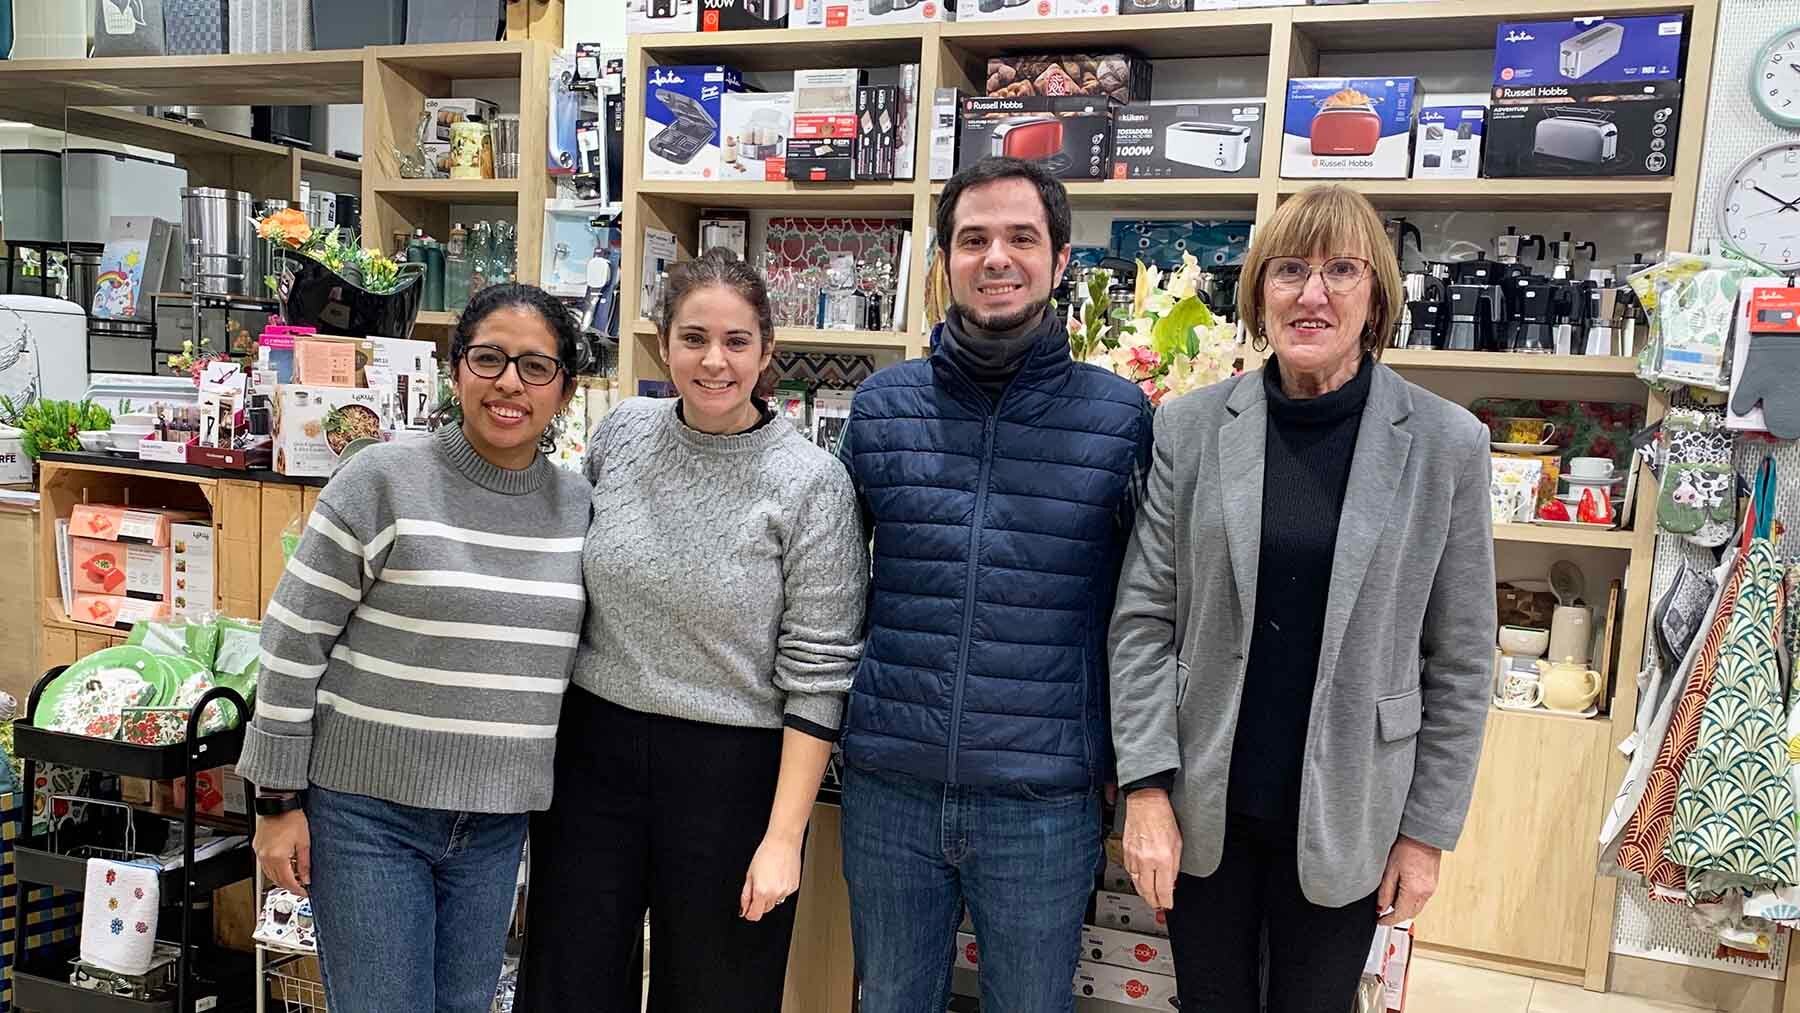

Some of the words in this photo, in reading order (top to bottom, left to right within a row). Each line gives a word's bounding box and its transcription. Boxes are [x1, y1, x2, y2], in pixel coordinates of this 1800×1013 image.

[1504, 88, 1536, 98] Russell
[1538, 87, 1568, 96] Hobbs
[973, 101, 998, 110] Russell
[1000, 101, 1024, 109] Hobbs
[1116, 146, 1154, 156] 1000W
[1319, 159, 1347, 168] Russell
[1348, 159, 1374, 168] Hobbs
[1730, 203, 1740, 216] 9
[1738, 228, 1748, 241] 8
[1759, 242, 1768, 255] 7
[1782, 247, 1791, 258] 6
